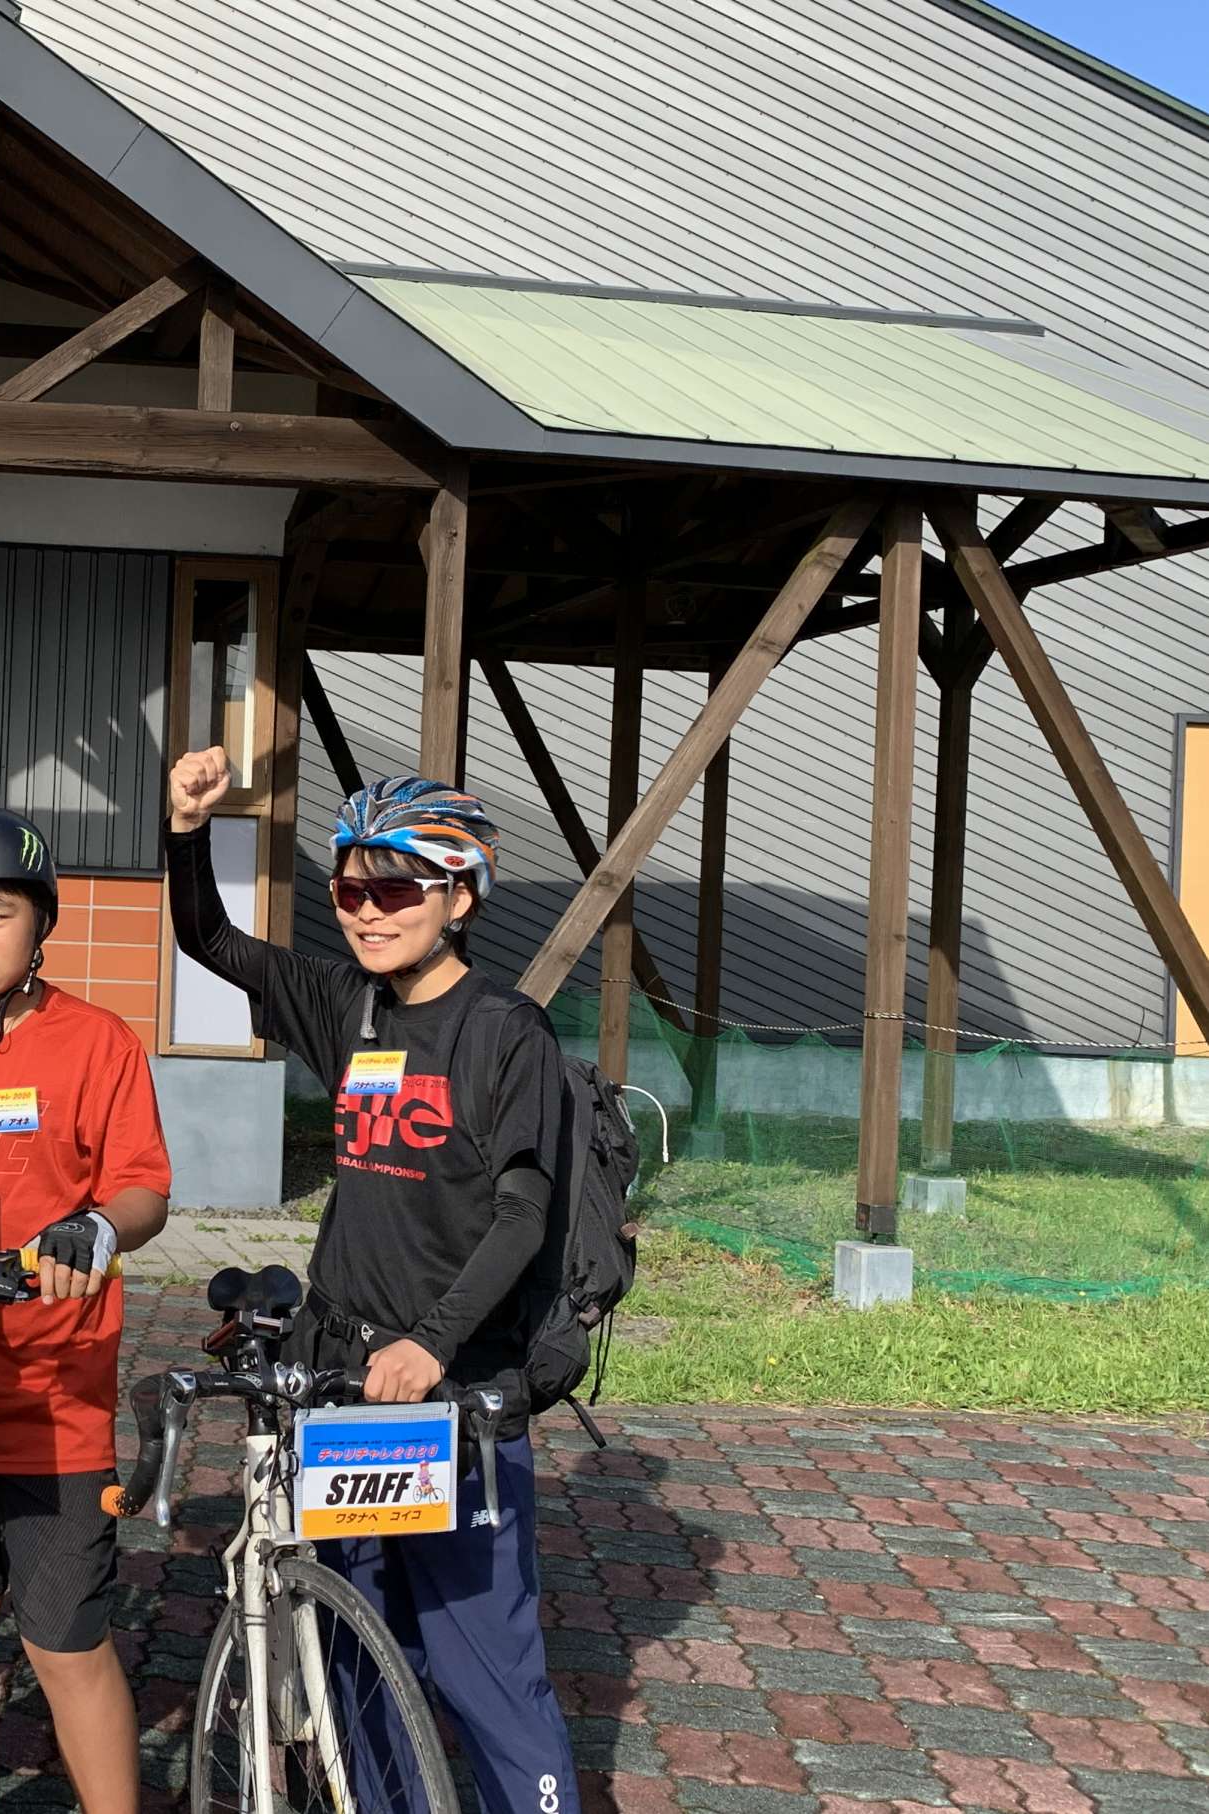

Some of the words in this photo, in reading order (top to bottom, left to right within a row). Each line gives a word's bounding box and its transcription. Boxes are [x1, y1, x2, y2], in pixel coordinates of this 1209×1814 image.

[8, 1117, 30, 1127] アオネ
[325, 1471, 415, 1506] STAFF
[390, 1510, 422, 1522] コイコ
